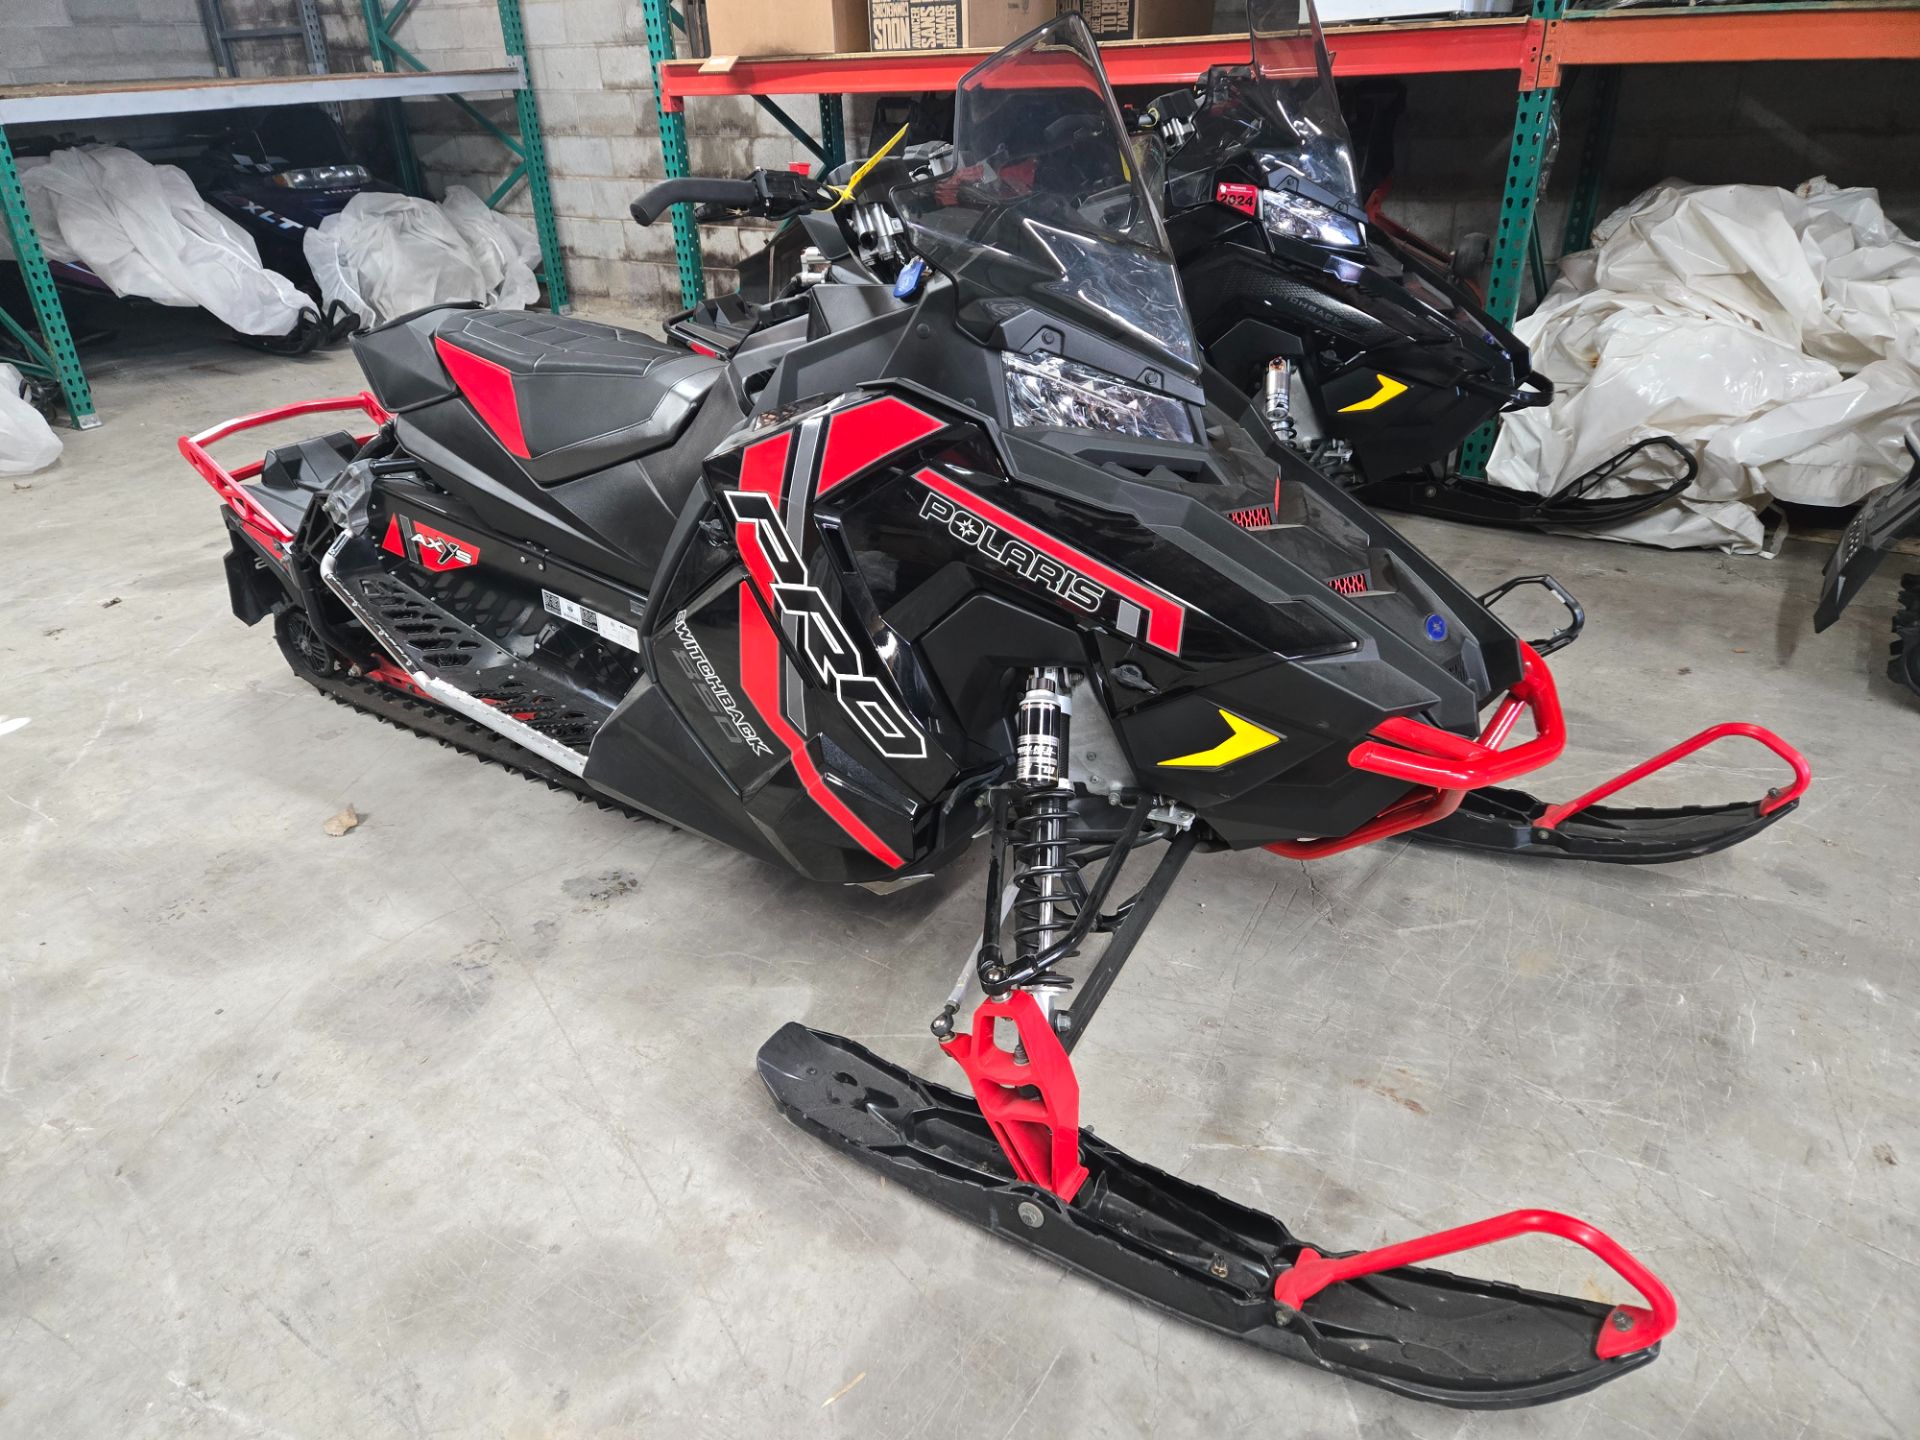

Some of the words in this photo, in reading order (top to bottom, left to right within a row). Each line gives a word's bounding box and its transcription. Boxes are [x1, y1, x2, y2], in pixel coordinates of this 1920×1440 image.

[873, 17, 910, 49] NOUS
[911, 7, 921, 48] AVANCER
[921, 6, 936, 48] SANS
[935, 5, 947, 47] JAMAIS
[947, 4, 957, 48] RECULER
[1091, 17, 1101, 33] ARE
[1101, 16, 1117, 33] TO
[241, 201, 304, 229] XLT
[1219, 194, 1253, 207] 2024
[411, 533, 472, 565] AXYS
[919, 491, 1107, 613] POLARIS
[724, 490, 927, 758] PRO
[671, 649, 743, 743] 850
[674, 609, 774, 757] SWITCHBACK
